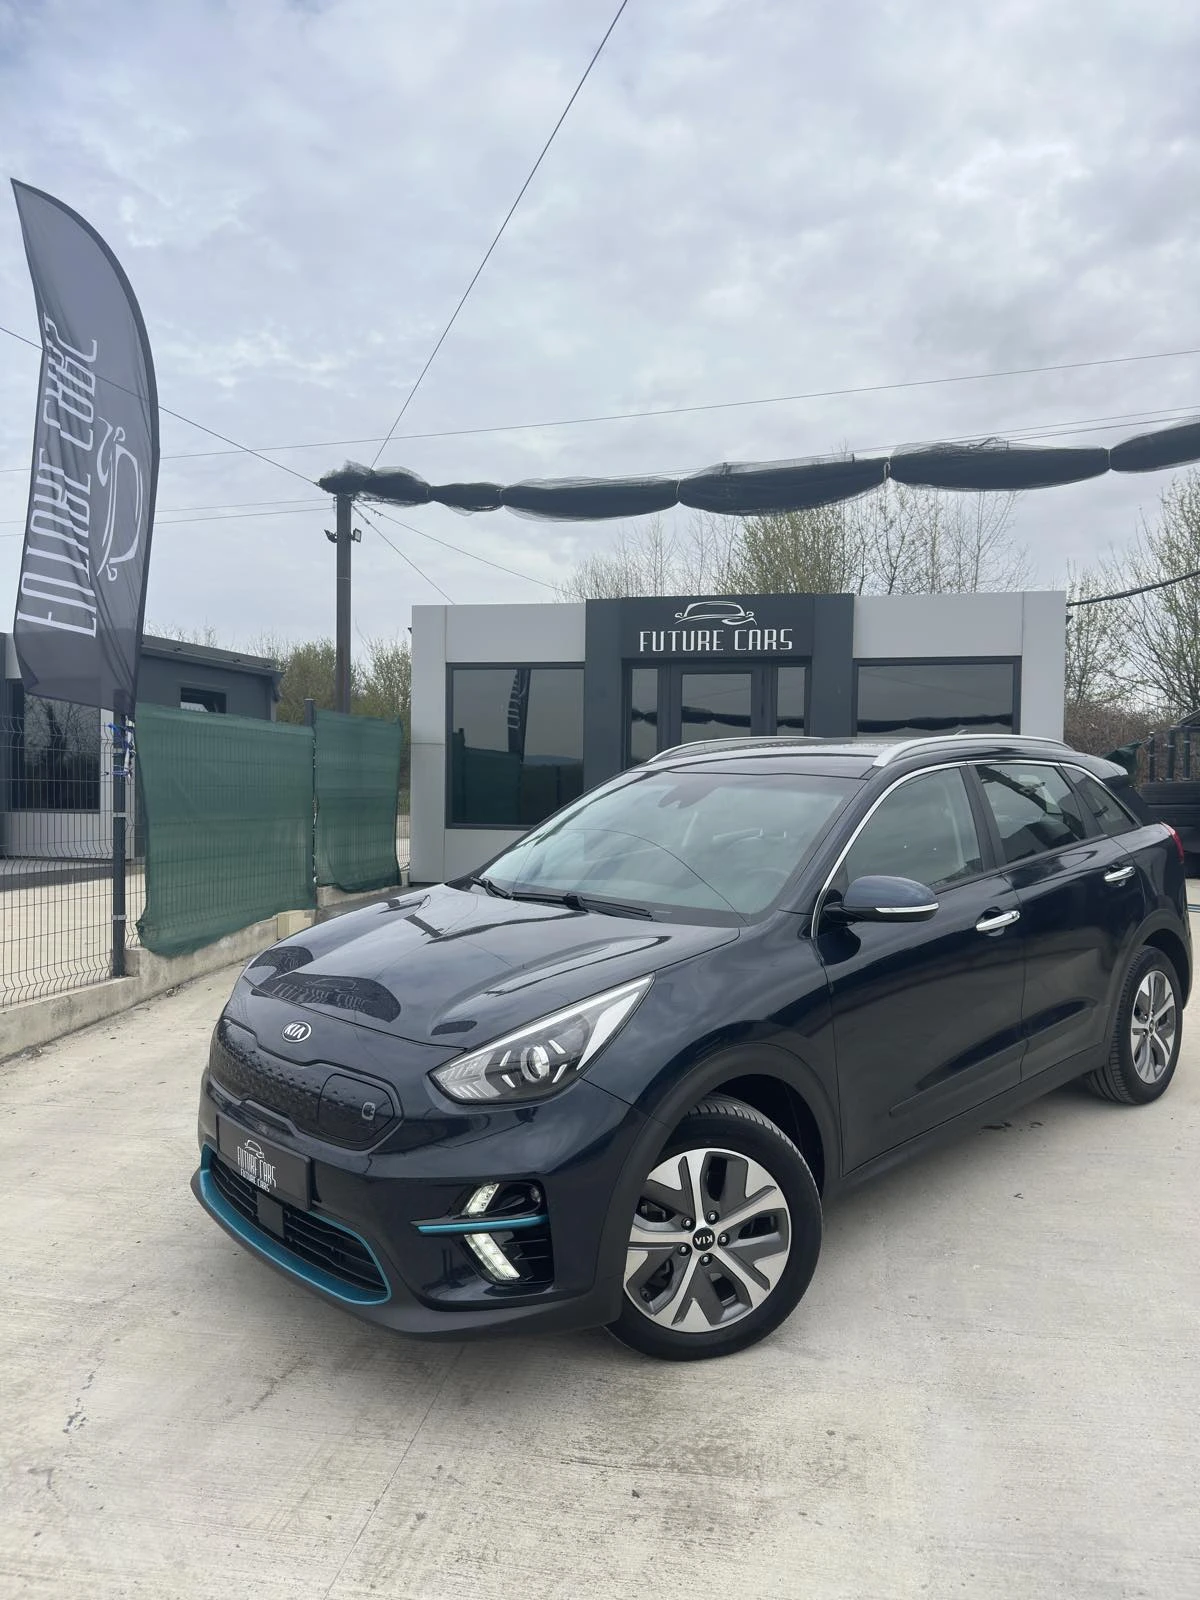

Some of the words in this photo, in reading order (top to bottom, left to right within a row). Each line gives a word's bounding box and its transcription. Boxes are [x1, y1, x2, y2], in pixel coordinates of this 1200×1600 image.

[639, 630, 724, 652] FUTURE
[734, 628, 793, 650] CARS
[284, 1023, 306, 1039] KIA
[237, 1146, 258, 1176] FUTURE
[259, 1160, 276, 1188] CARS
[694, 1234, 713, 1245] KIA
